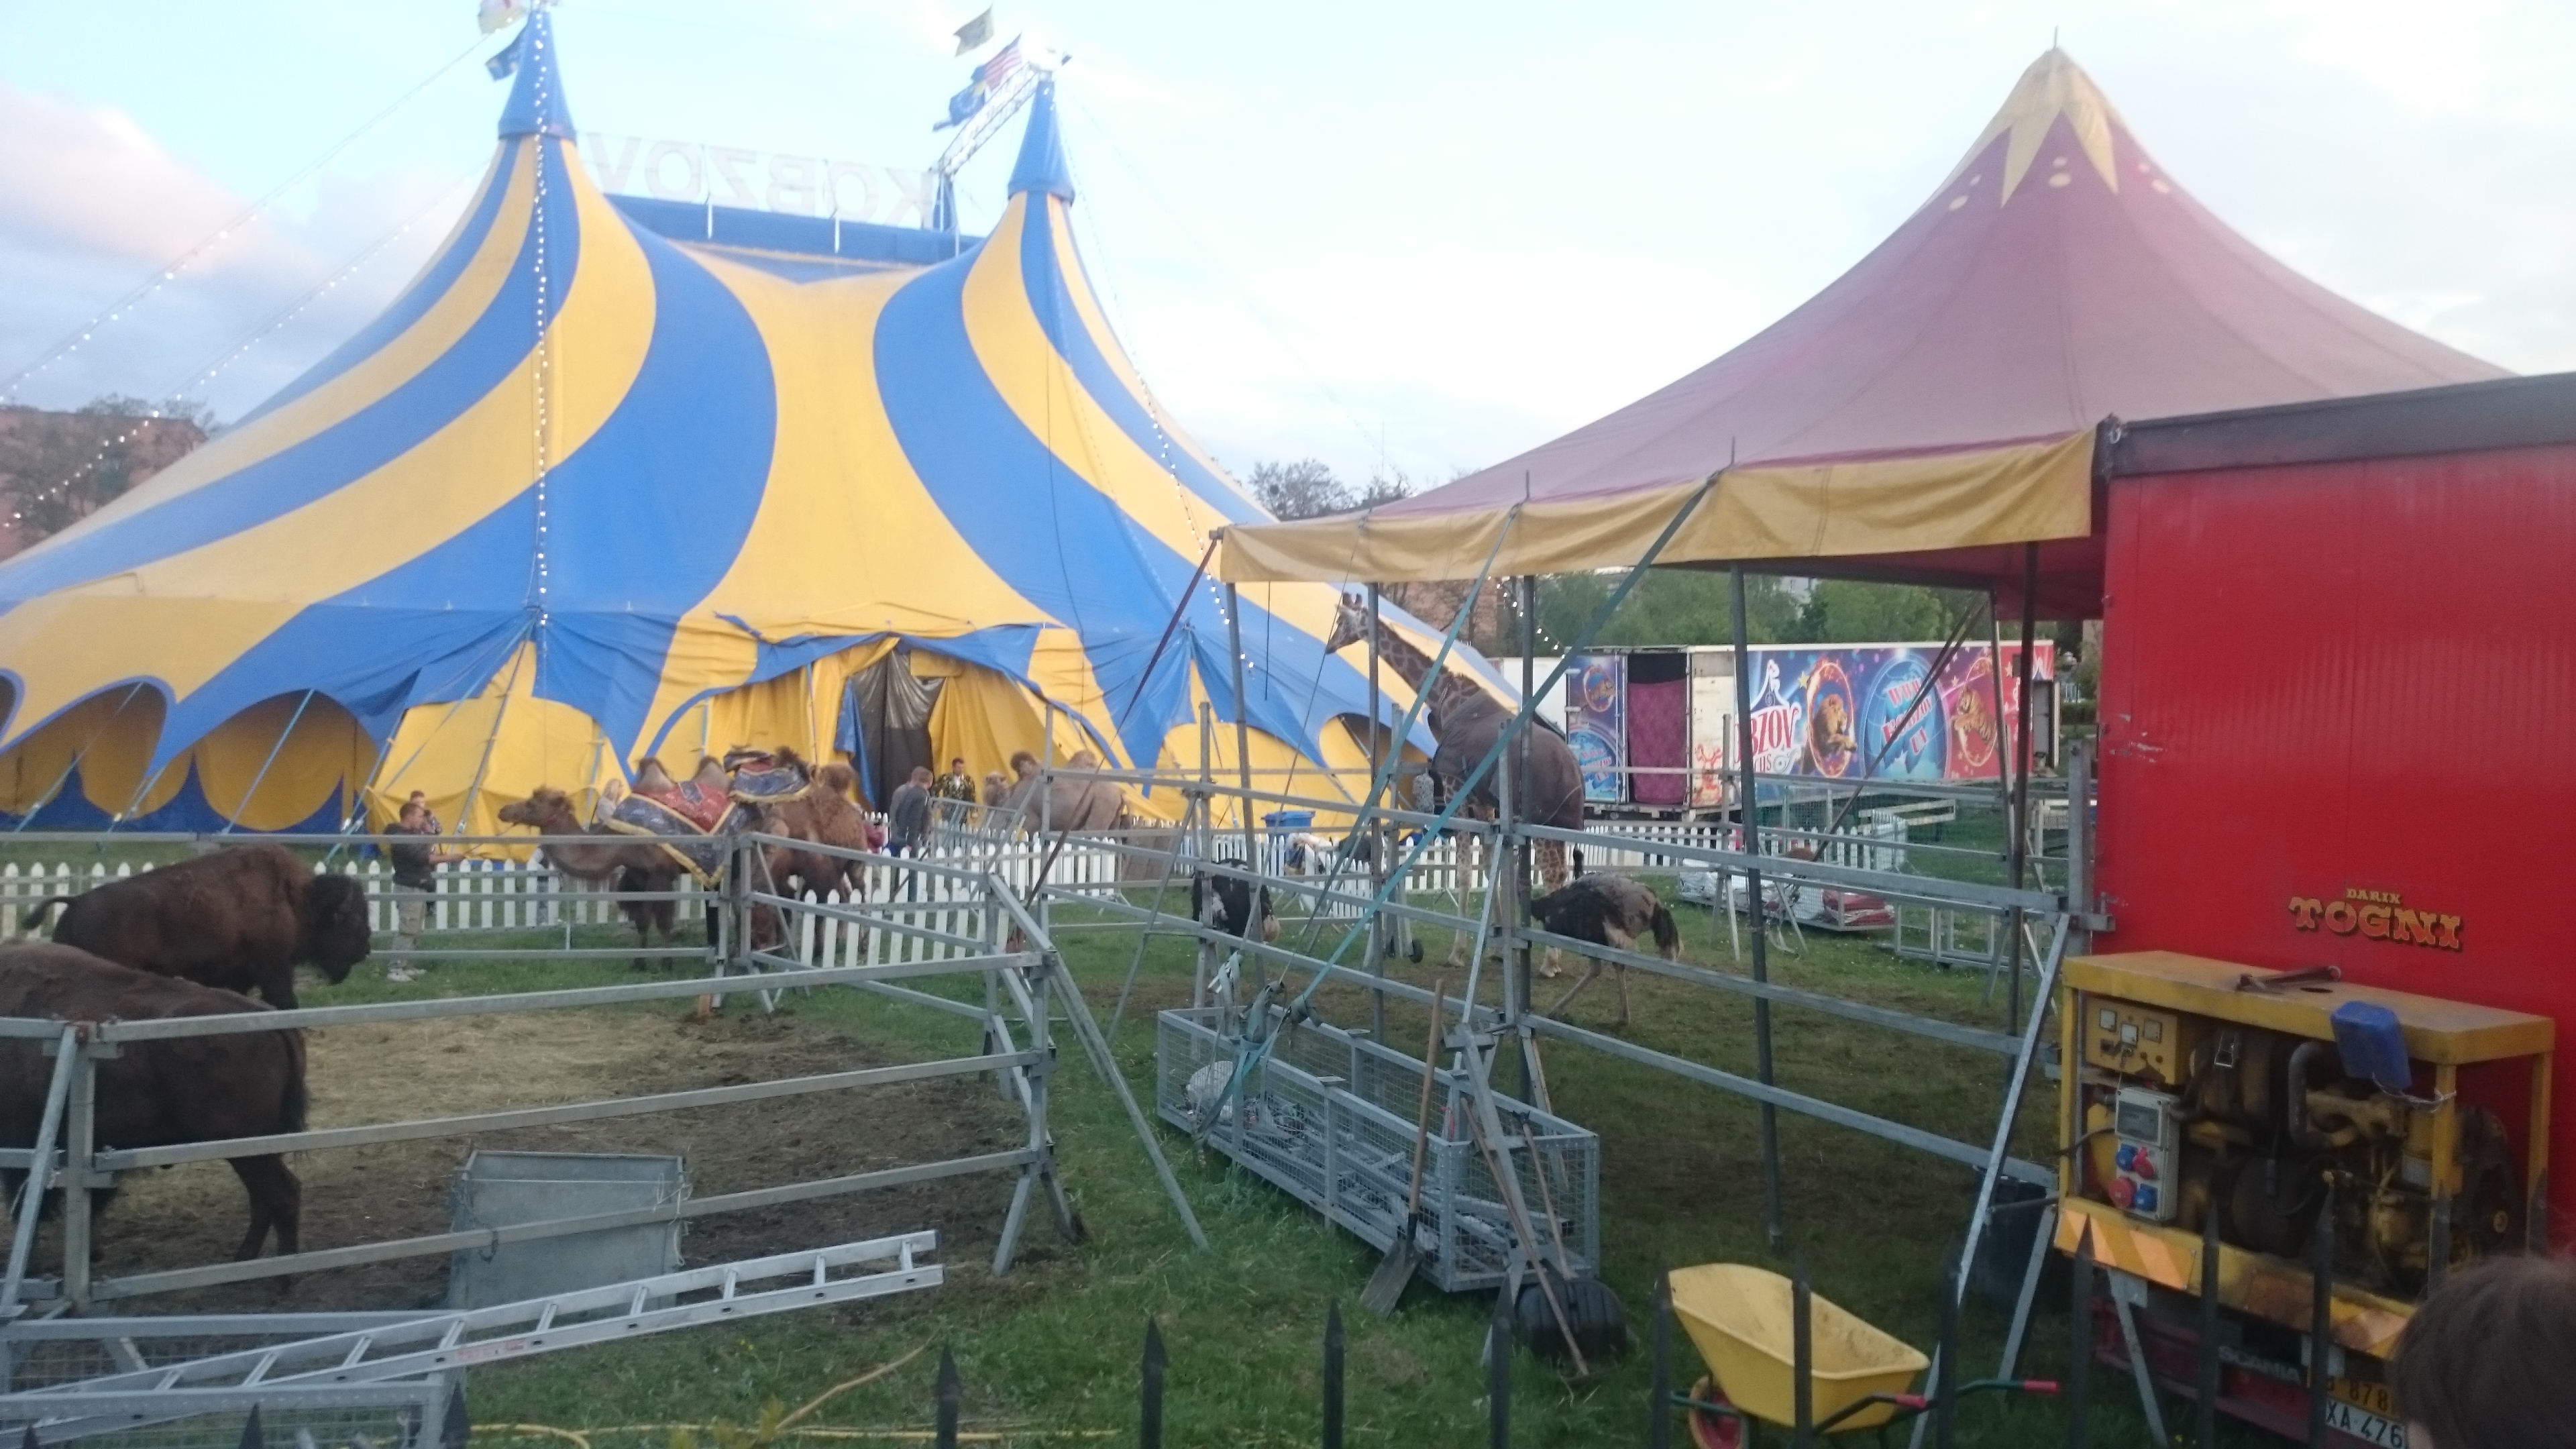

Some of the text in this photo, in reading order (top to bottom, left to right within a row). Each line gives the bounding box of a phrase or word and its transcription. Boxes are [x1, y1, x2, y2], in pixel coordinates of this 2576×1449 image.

[2346, 888, 2401, 904] DARIX
[2288, 896, 2461, 949] TOGNI
[2361, 1415, 2404, 1448] 476
